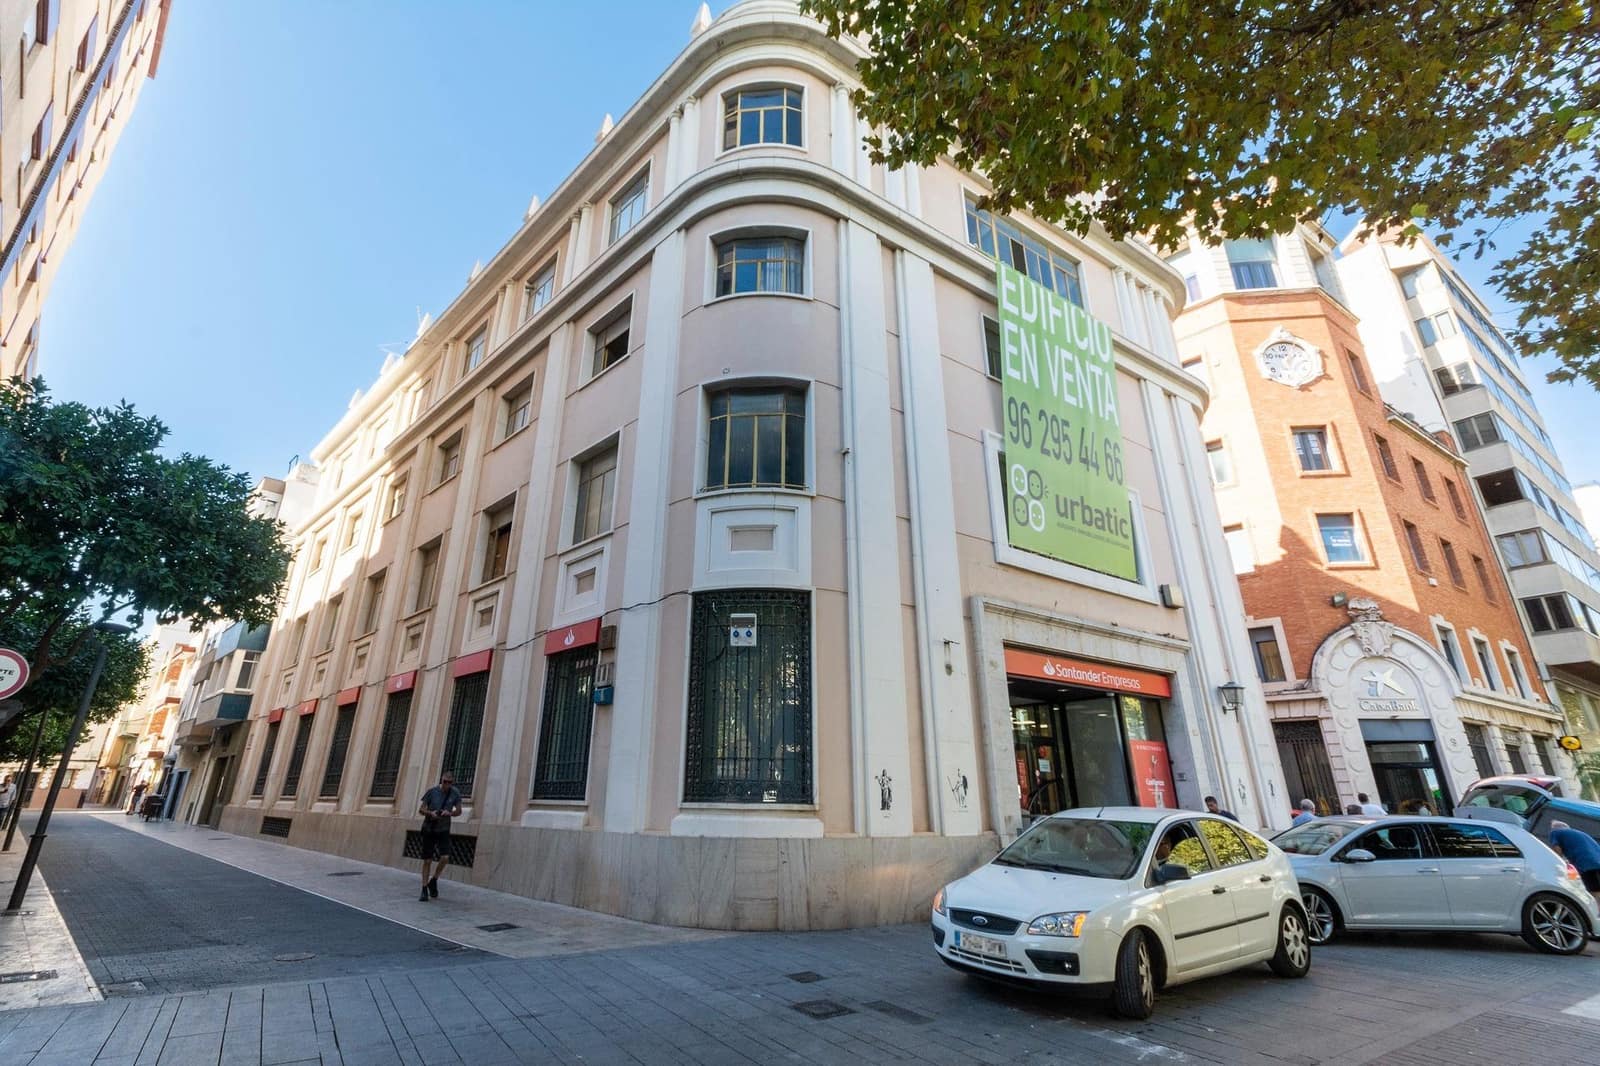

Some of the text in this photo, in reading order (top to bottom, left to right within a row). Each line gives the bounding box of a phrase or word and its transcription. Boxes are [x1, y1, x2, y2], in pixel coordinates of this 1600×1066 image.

[1001, 265, 1111, 363] EDIFICIO
[1004, 319, 1119, 427] EN VENTA
[1008, 396, 1123, 486] 96 295 44 66
[1055, 494, 1129, 539] urbatic
[1055, 664, 1141, 689] Santander Empresas
[1359, 700, 1421, 712] CaixaBank
